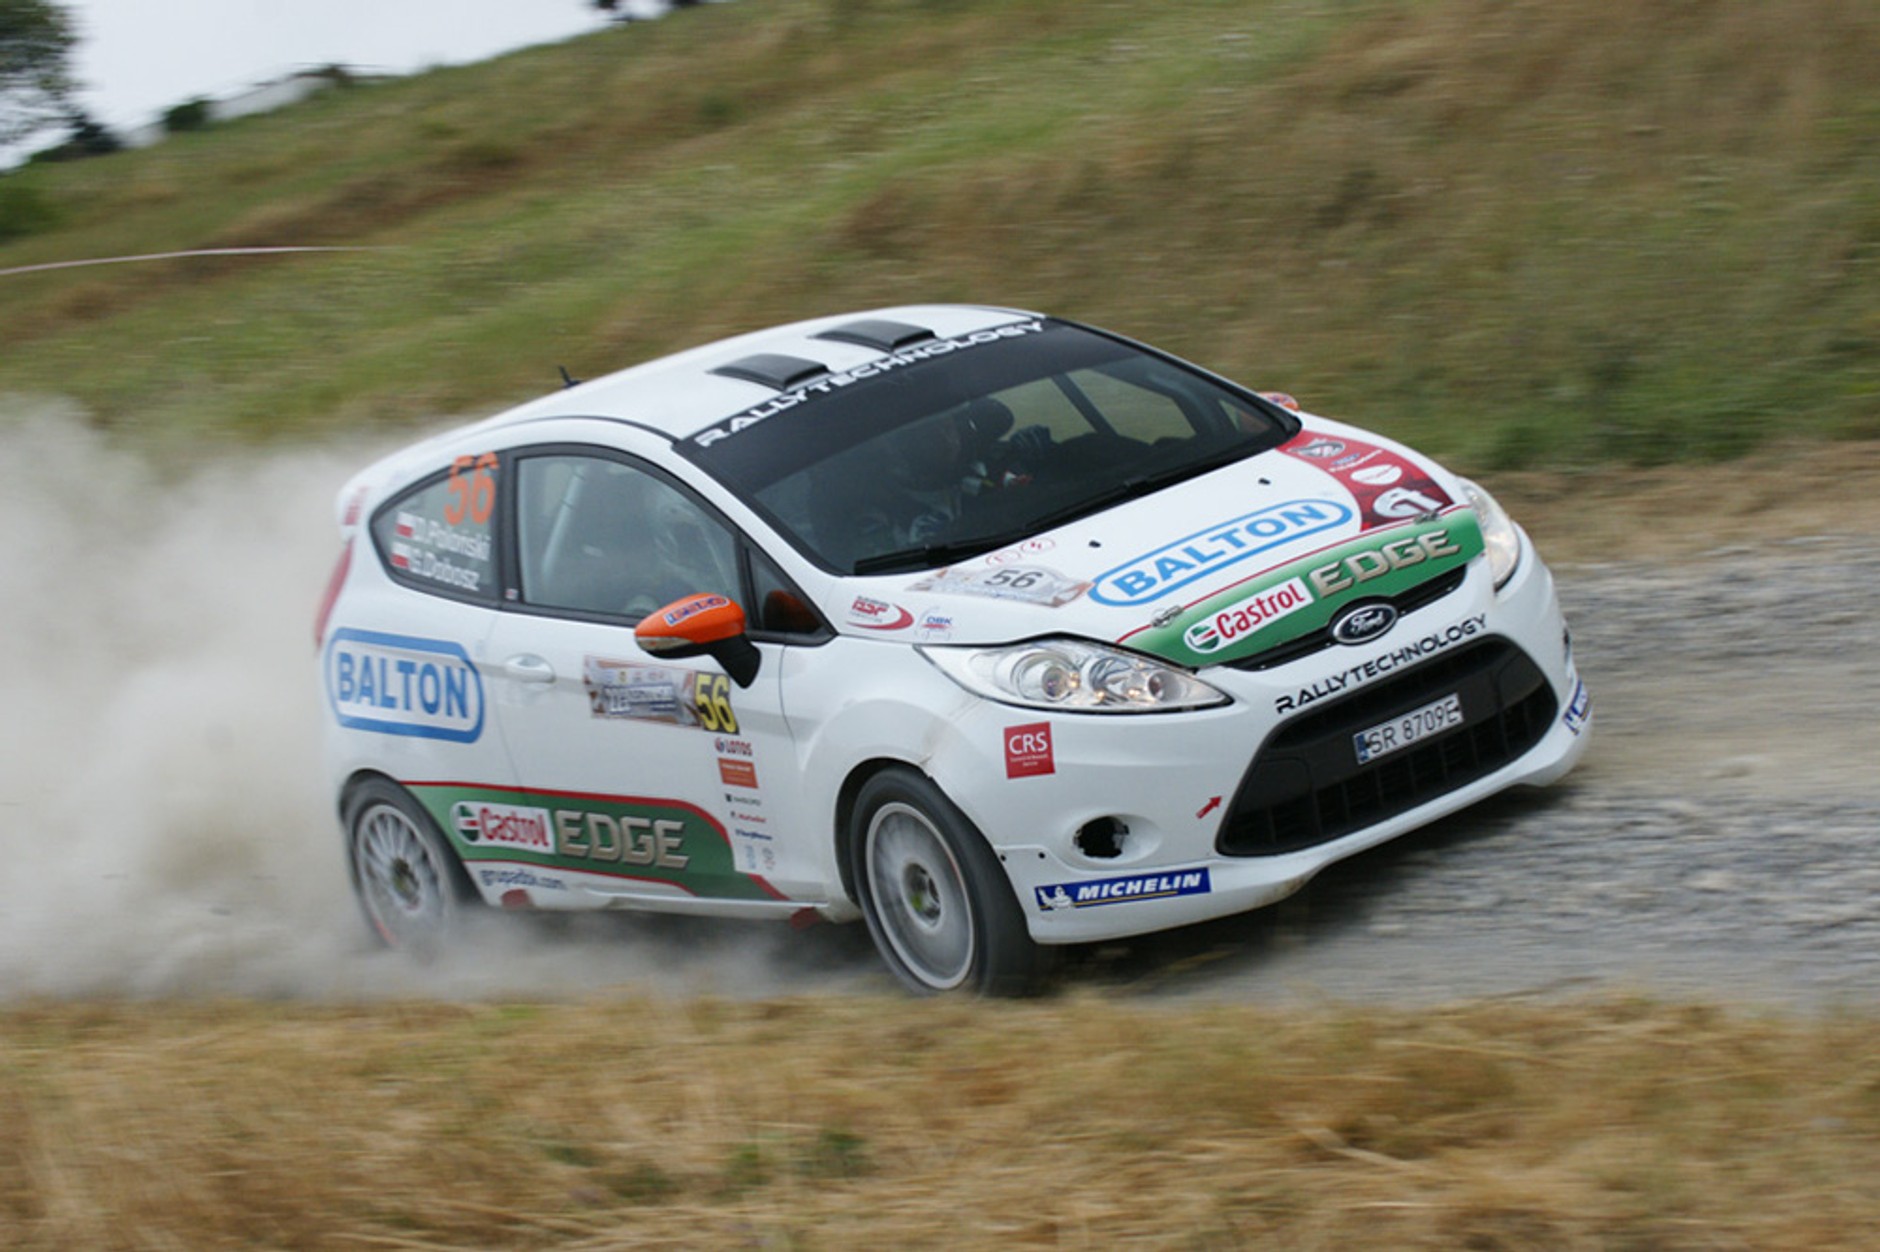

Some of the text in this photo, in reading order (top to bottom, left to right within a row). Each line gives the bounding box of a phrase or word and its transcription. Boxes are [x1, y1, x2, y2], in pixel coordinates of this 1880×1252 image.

[443, 452, 499, 527] 56
[984, 569, 1043, 588] 56
[1111, 505, 1328, 597] BALTON
[1216, 529, 1460, 639] Castrol EDGE
[1350, 610, 1384, 635] Ford
[337, 651, 469, 719] BALTON
[695, 673, 737, 733] 56
[1009, 731, 1048, 755] CRS
[1368, 699, 1459, 754] SR 8709E
[480, 807, 549, 847] Castrol
[555, 810, 690, 869] EDGE
[1077, 872, 1202, 901] MICHELIN
